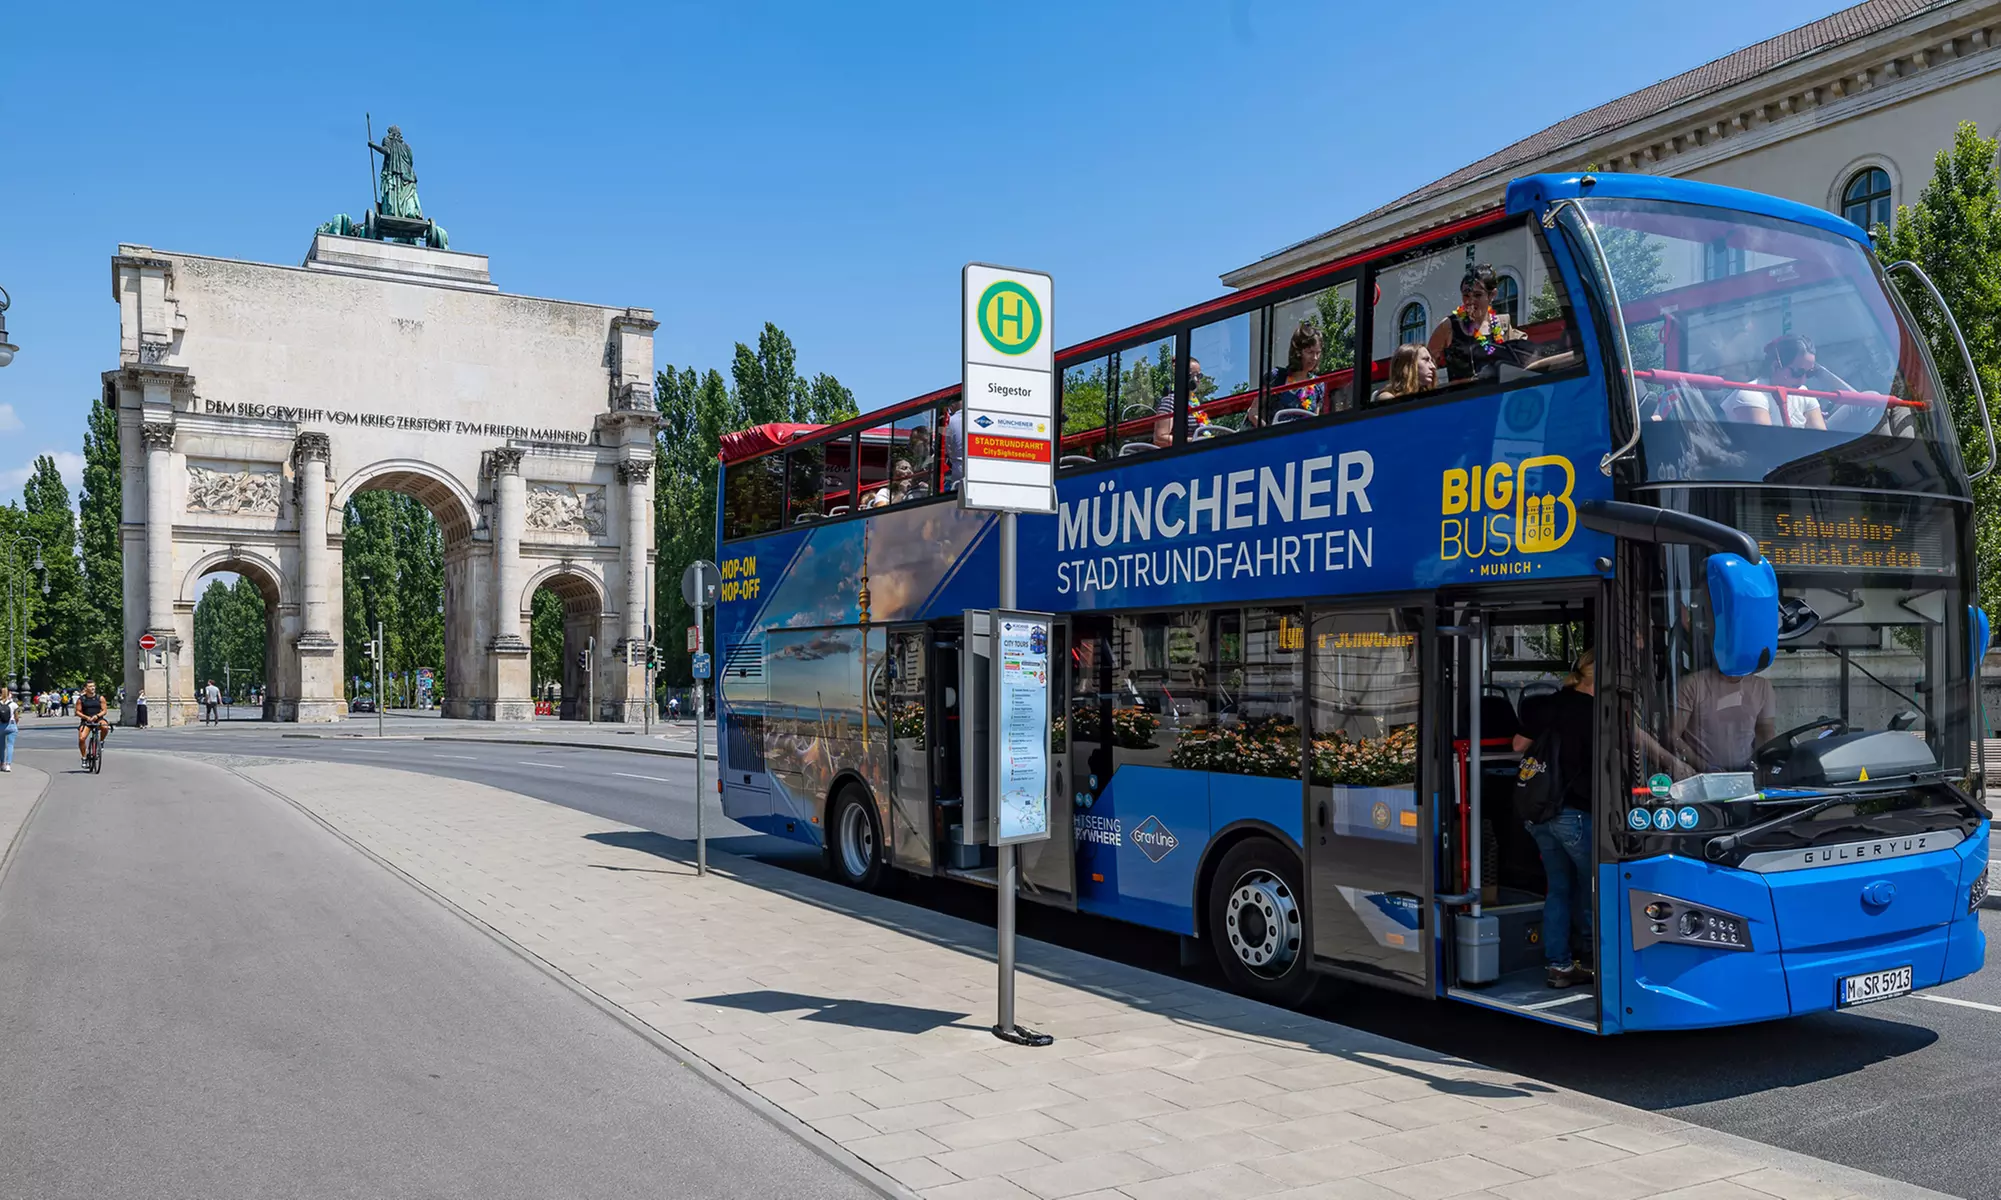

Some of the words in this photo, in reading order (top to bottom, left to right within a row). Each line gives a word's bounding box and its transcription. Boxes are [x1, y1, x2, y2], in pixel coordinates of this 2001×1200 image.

[997, 296, 1023, 340] H
[988, 382, 1032, 398] Siegestor
[205, 399, 235, 414] DEM
[238, 402, 265, 418] SIEG
[266, 405, 324, 423] GEWEIHT
[326, 410, 358, 426] VOM
[360, 413, 395, 429] KRIEG
[455, 420, 482, 436] ZVM
[483, 423, 529, 440] FRIEDEN
[530, 428, 588, 444] MAHNEND
[975, 436, 1044, 450] STADTRUNDFAHRT
[983, 447, 1037, 460] CitySightseeing
[1057, 450, 1375, 552] MÜNCHENER
[1442, 462, 1513, 515] BIG
[1441, 513, 1511, 560] BUS
[721, 556, 756, 580] HOP-ON
[1057, 527, 1373, 594] STADTRUNDFAHRTEN
[1480, 561, 1532, 576] MUNICH
[1847, 544, 1922, 568] Garden
[721, 578, 760, 602] HOP-OFF
[1804, 838, 1926, 863] GULERYUZ
[1847, 979, 1856, 999] M
[1864, 975, 1880, 996] SR
[1882, 968, 1910, 992] 5913
